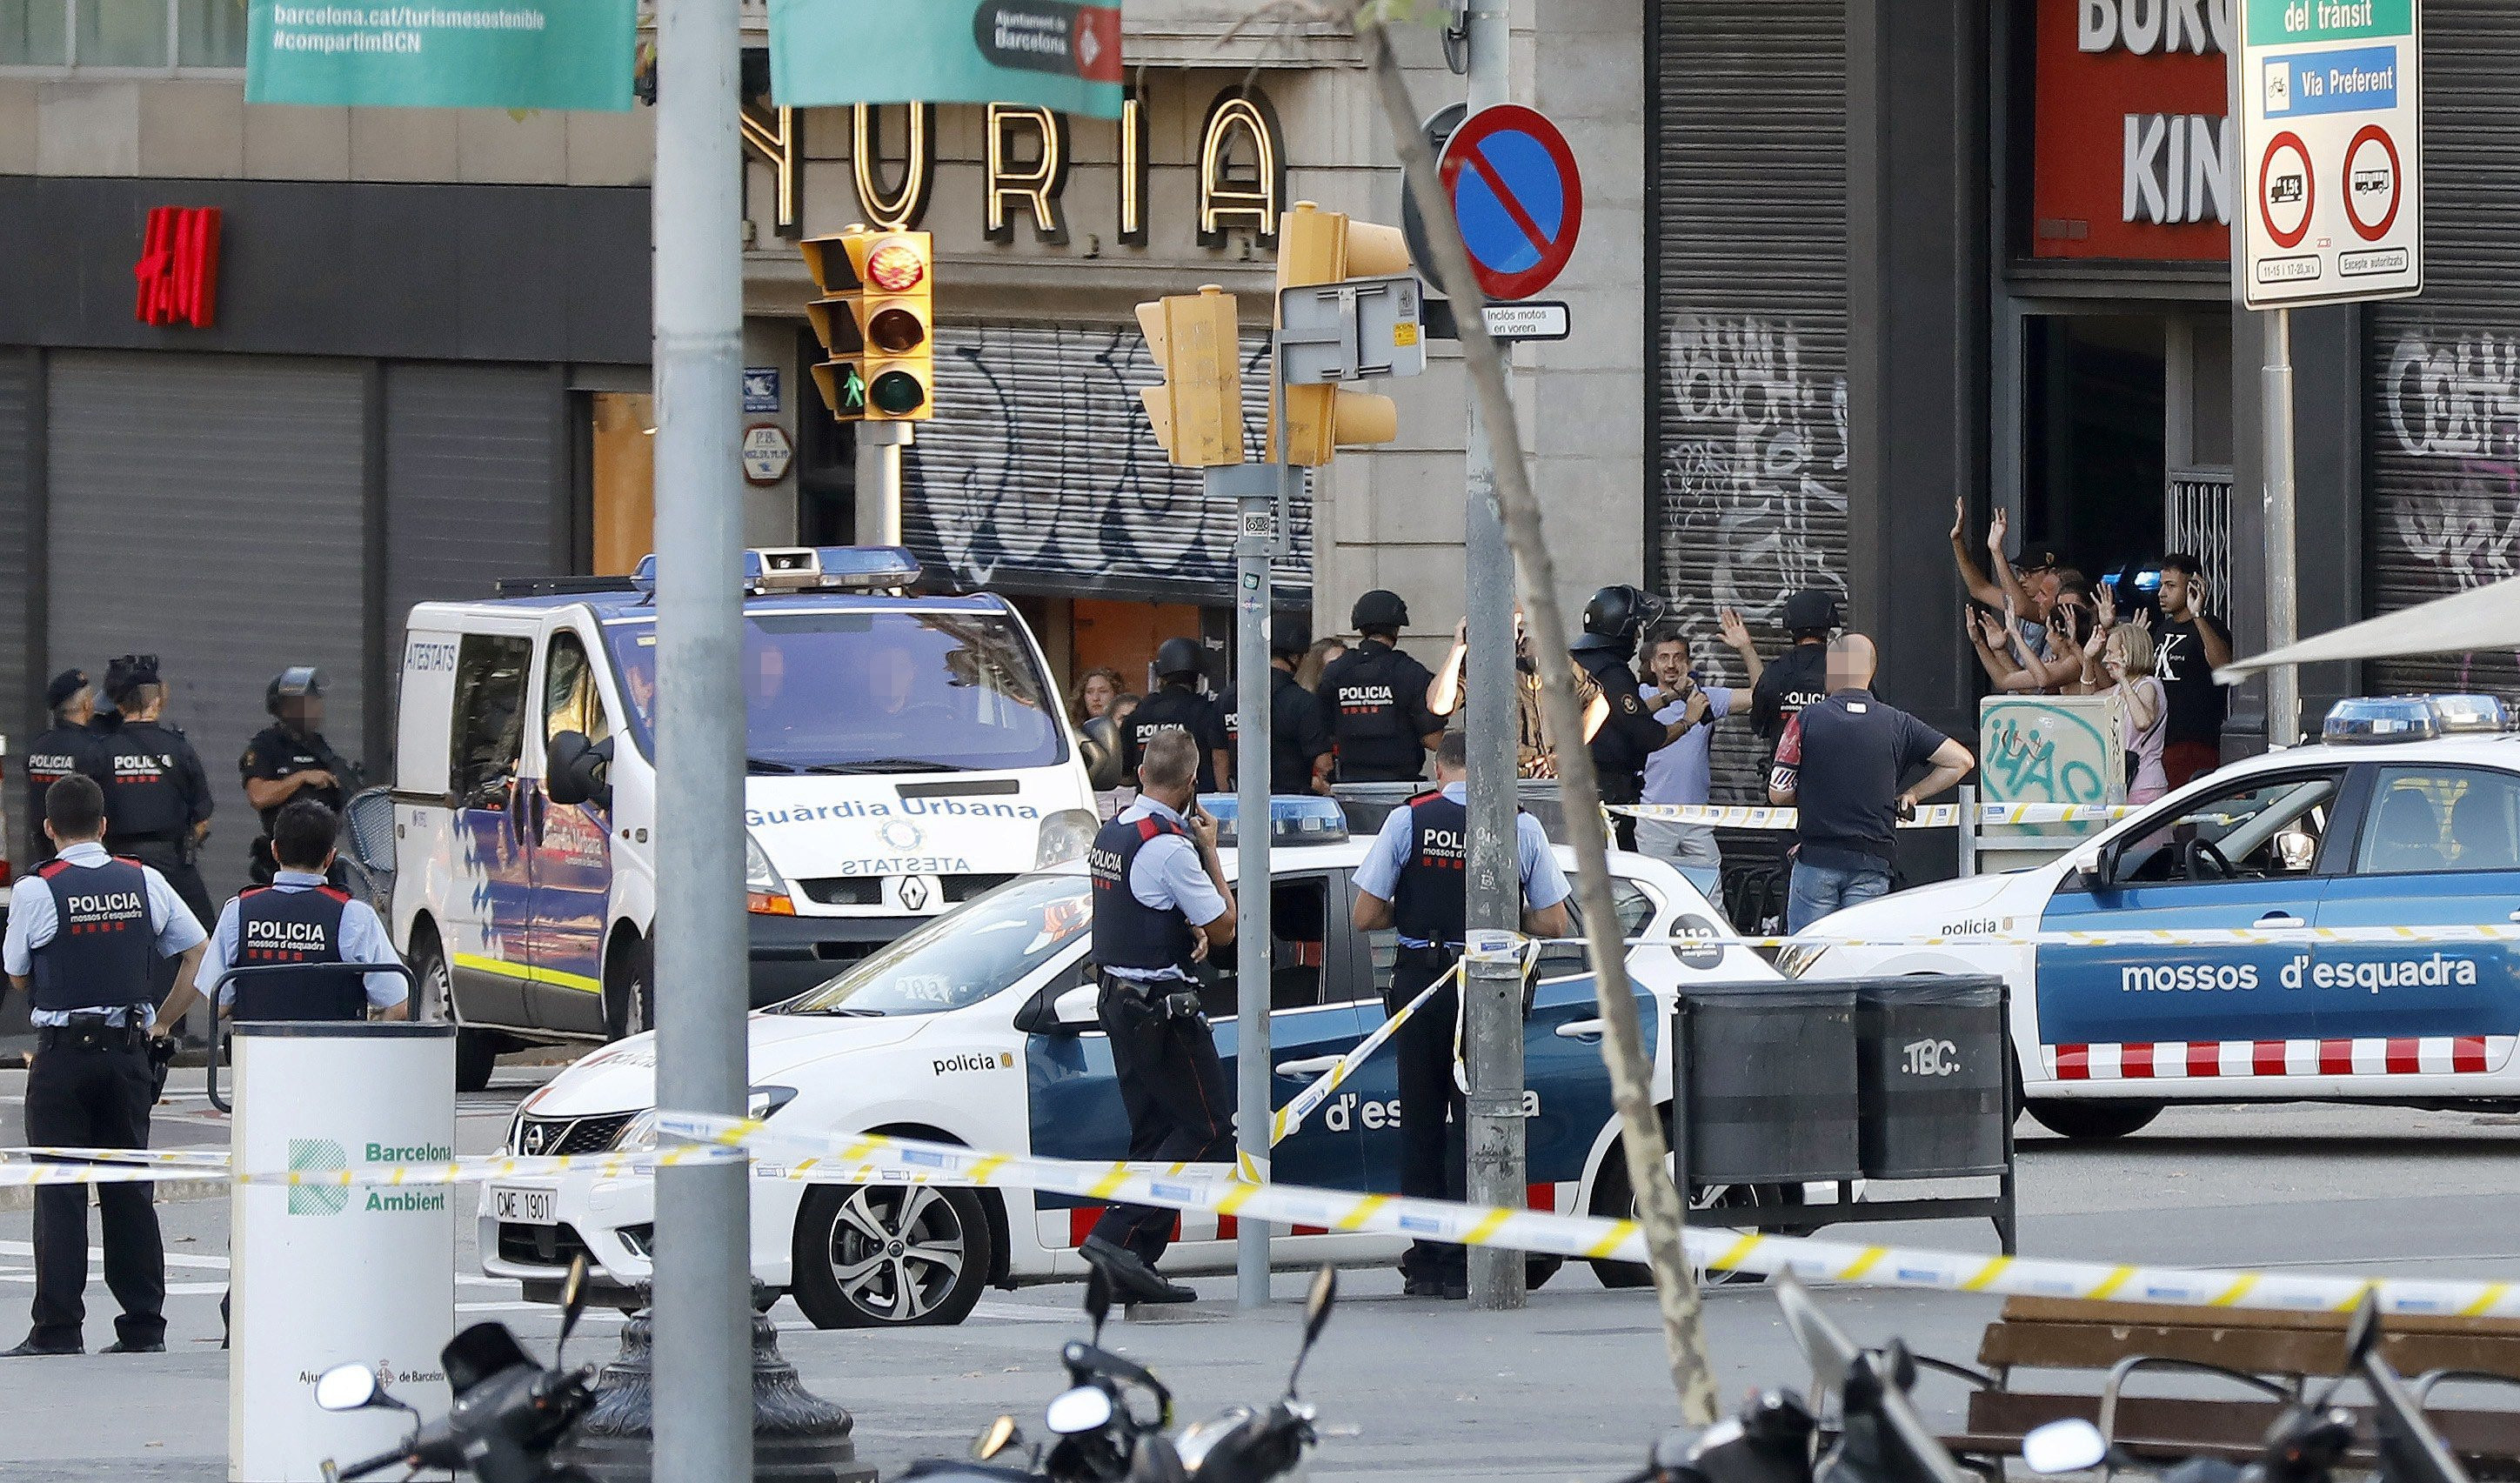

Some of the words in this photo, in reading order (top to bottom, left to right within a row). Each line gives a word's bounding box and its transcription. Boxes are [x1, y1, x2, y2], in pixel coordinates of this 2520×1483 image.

[2284, 0, 2309, 32] del
[2317, 0, 2372, 30] trànsit
[274, 30, 421, 54] #compartimBCN
[995, 26, 1067, 55] Barcelona
[2302, 70, 2323, 97] Via
[2329, 65, 2393, 95] Preferent
[2122, 113, 2230, 225] KIN
[1518, 310, 1547, 320] motos
[1494, 324, 1506, 334] en
[1507, 324, 1536, 334] vorera
[406, 643, 457, 671] ATESTATS
[1339, 686, 1393, 699] POLICIA
[29, 754, 75, 768] POLICIA
[745, 800, 891, 826] Guàrdia
[900, 798, 1039, 819] Urbana
[1091, 848, 1121, 872] POLICIA
[1423, 848, 1454, 858] mossos
[67, 892, 142, 913] POLICIA
[70, 913, 101, 923] mossos
[102, 910, 143, 922] d'esquadra
[1942, 918, 1996, 936] policia
[247, 920, 325, 941] POLICIA
[248, 939, 278, 949] mossos
[280, 939, 325, 951] d'esquadra
[2122, 964, 2259, 992] mossos
[2280, 952, 2477, 994] d'esquadra
[932, 1052, 996, 1076] policia
[365, 1142, 451, 1162] Barcelona
[365, 1192, 445, 1212] Ambient
[497, 1192, 517, 1218] CME
[525, 1193, 550, 1219] 1901
[399, 1372, 411, 1382] de
